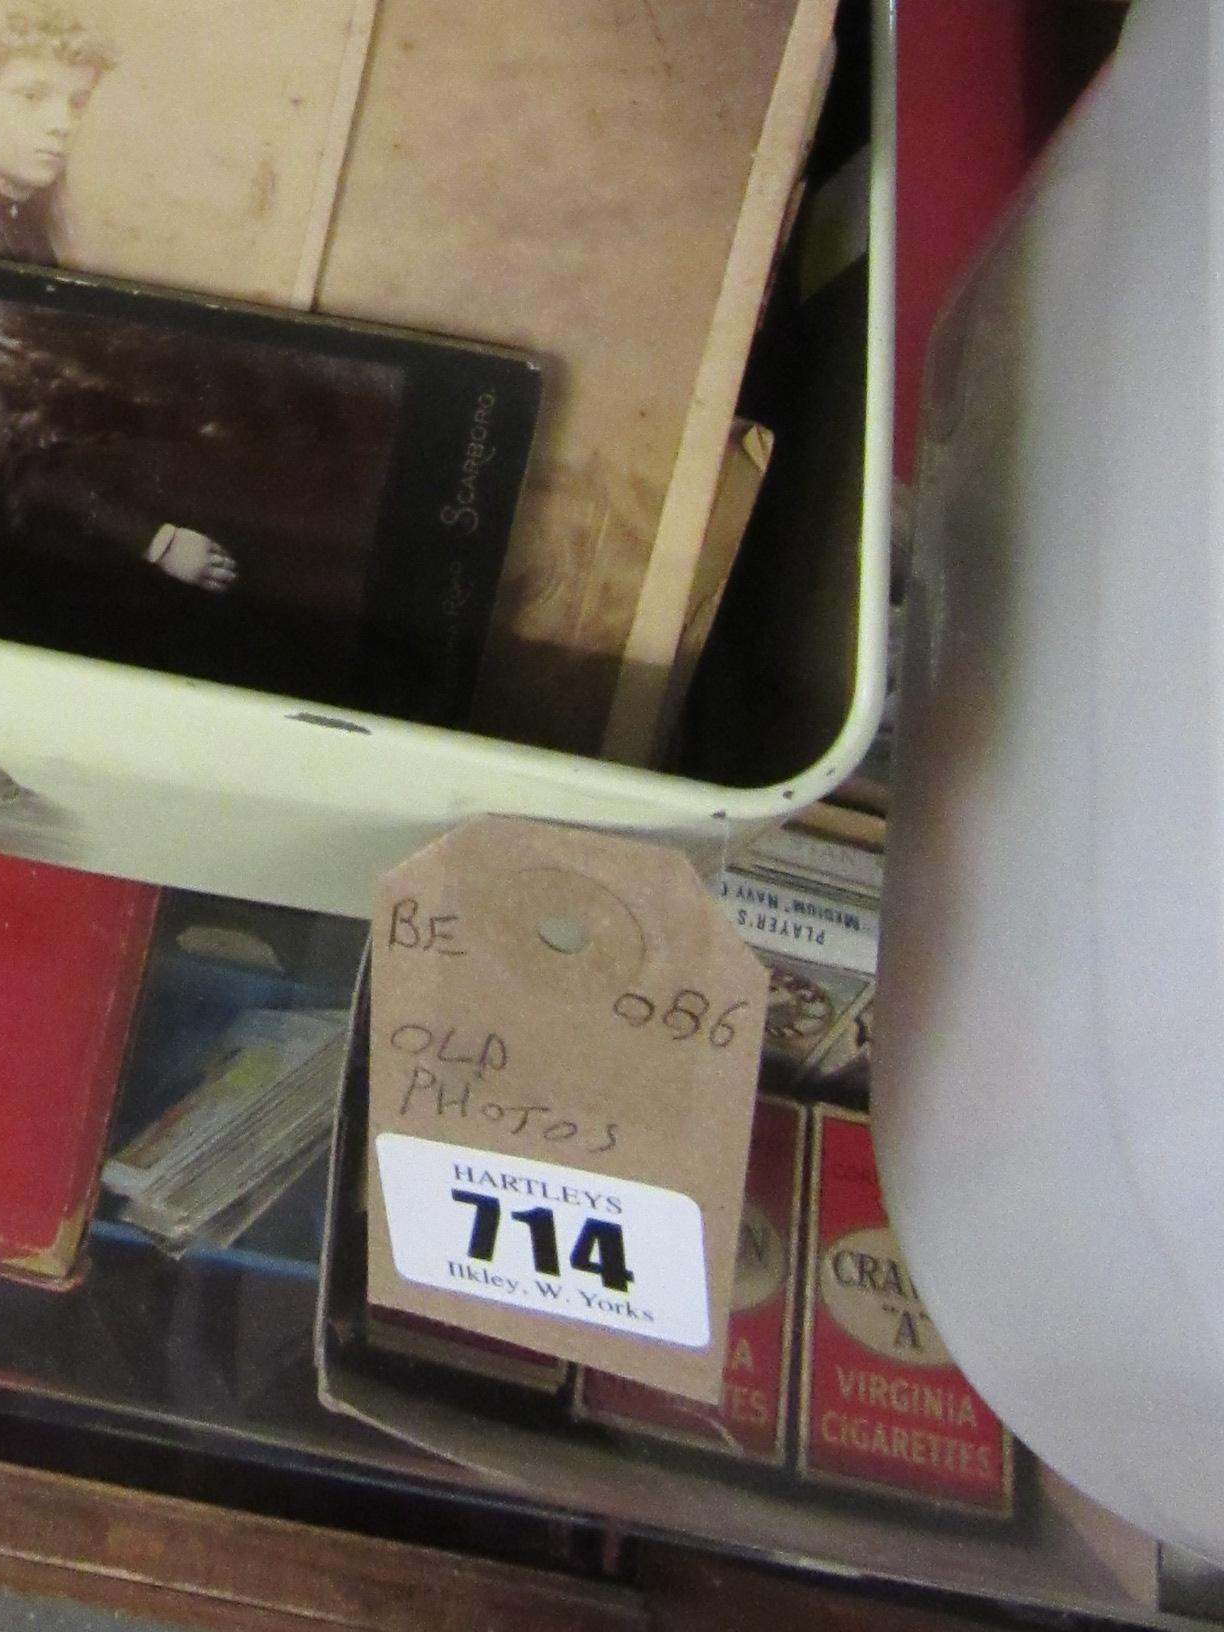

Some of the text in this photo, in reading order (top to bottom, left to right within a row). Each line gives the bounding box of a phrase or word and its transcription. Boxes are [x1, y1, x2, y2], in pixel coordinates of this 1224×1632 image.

[388, 896, 467, 956] BE
[735, 885, 779, 909] NAVY
[737, 909, 826, 945] PLAYER'S
[390, 1024, 508, 1080] OLD
[399, 1066, 619, 1153] PHOTOS
[453, 1163, 623, 1215] HARTLEYS
[450, 1187, 636, 1294] 714
[577, 1288, 655, 1322] Yorks
[835, 1366, 980, 1428] VIRGINIA
[821, 1410, 991, 1477] CIGARETTES
